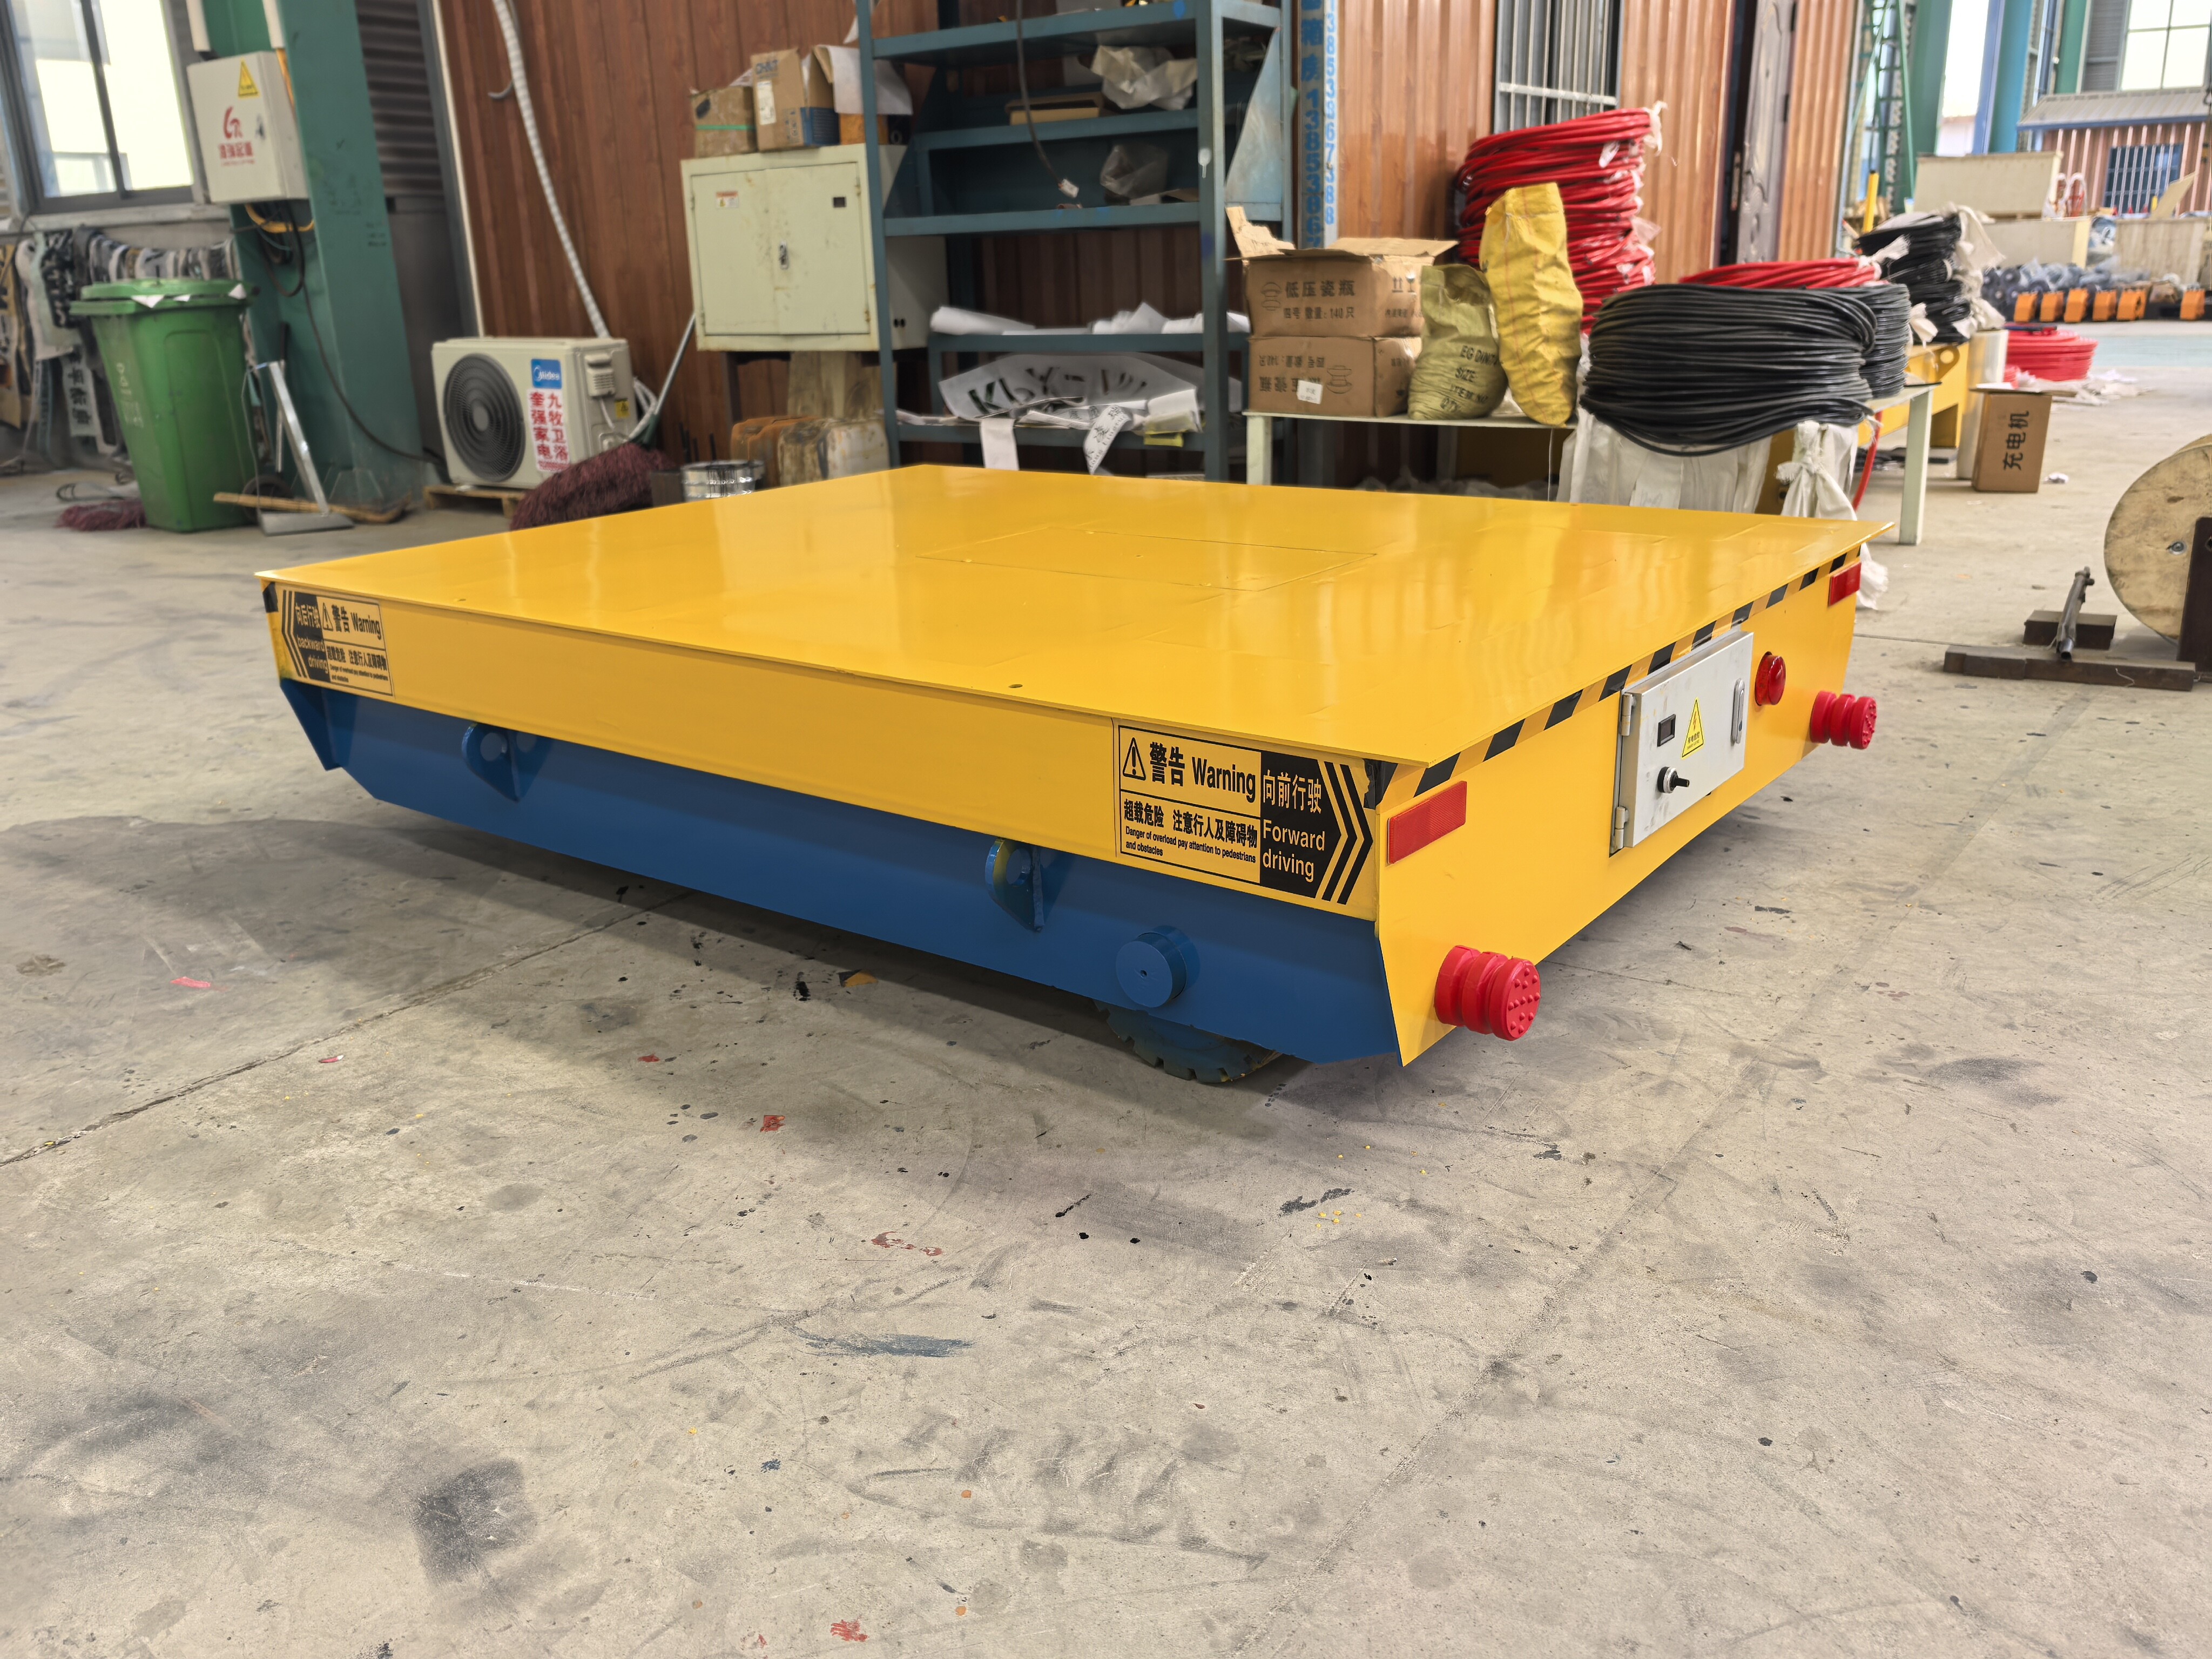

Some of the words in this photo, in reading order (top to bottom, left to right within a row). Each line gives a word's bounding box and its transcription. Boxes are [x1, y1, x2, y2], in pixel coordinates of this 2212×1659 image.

[1285, 279, 1355, 298] 低压瓷瓶
[535, 367, 559, 381] Midea
[2002, 410, 2029, 471] 充电机
[295, 603, 322, 629] 向后行驶
[332, 604, 350, 633] 警告
[351, 612, 381, 640] Warning
[297, 636, 325, 652] backward
[308, 654, 328, 674] driving
[1150, 741, 1185, 787] 警告
[1192, 756, 1256, 803] Warning
[1263, 769, 1321, 814] 向前行驶
[1124, 798, 1164, 828] 超载危险
[1172, 809, 1258, 848] 注意行人及障碍物
[1263, 819, 1325, 851] Forward
[1125, 825, 1145, 839] Danger
[1147, 831, 1152, 840] of
[1153, 833, 1177, 846] overload
[1178, 839, 1188, 850] pay
[1189, 840, 1213, 854] attention
[1215, 846, 1221, 855] to
[1222, 848, 1256, 864] pedestrians
[1125, 841, 1136, 850] and
[1137, 842, 1163, 857] obstacles
[1263, 848, 1314, 883] driving
